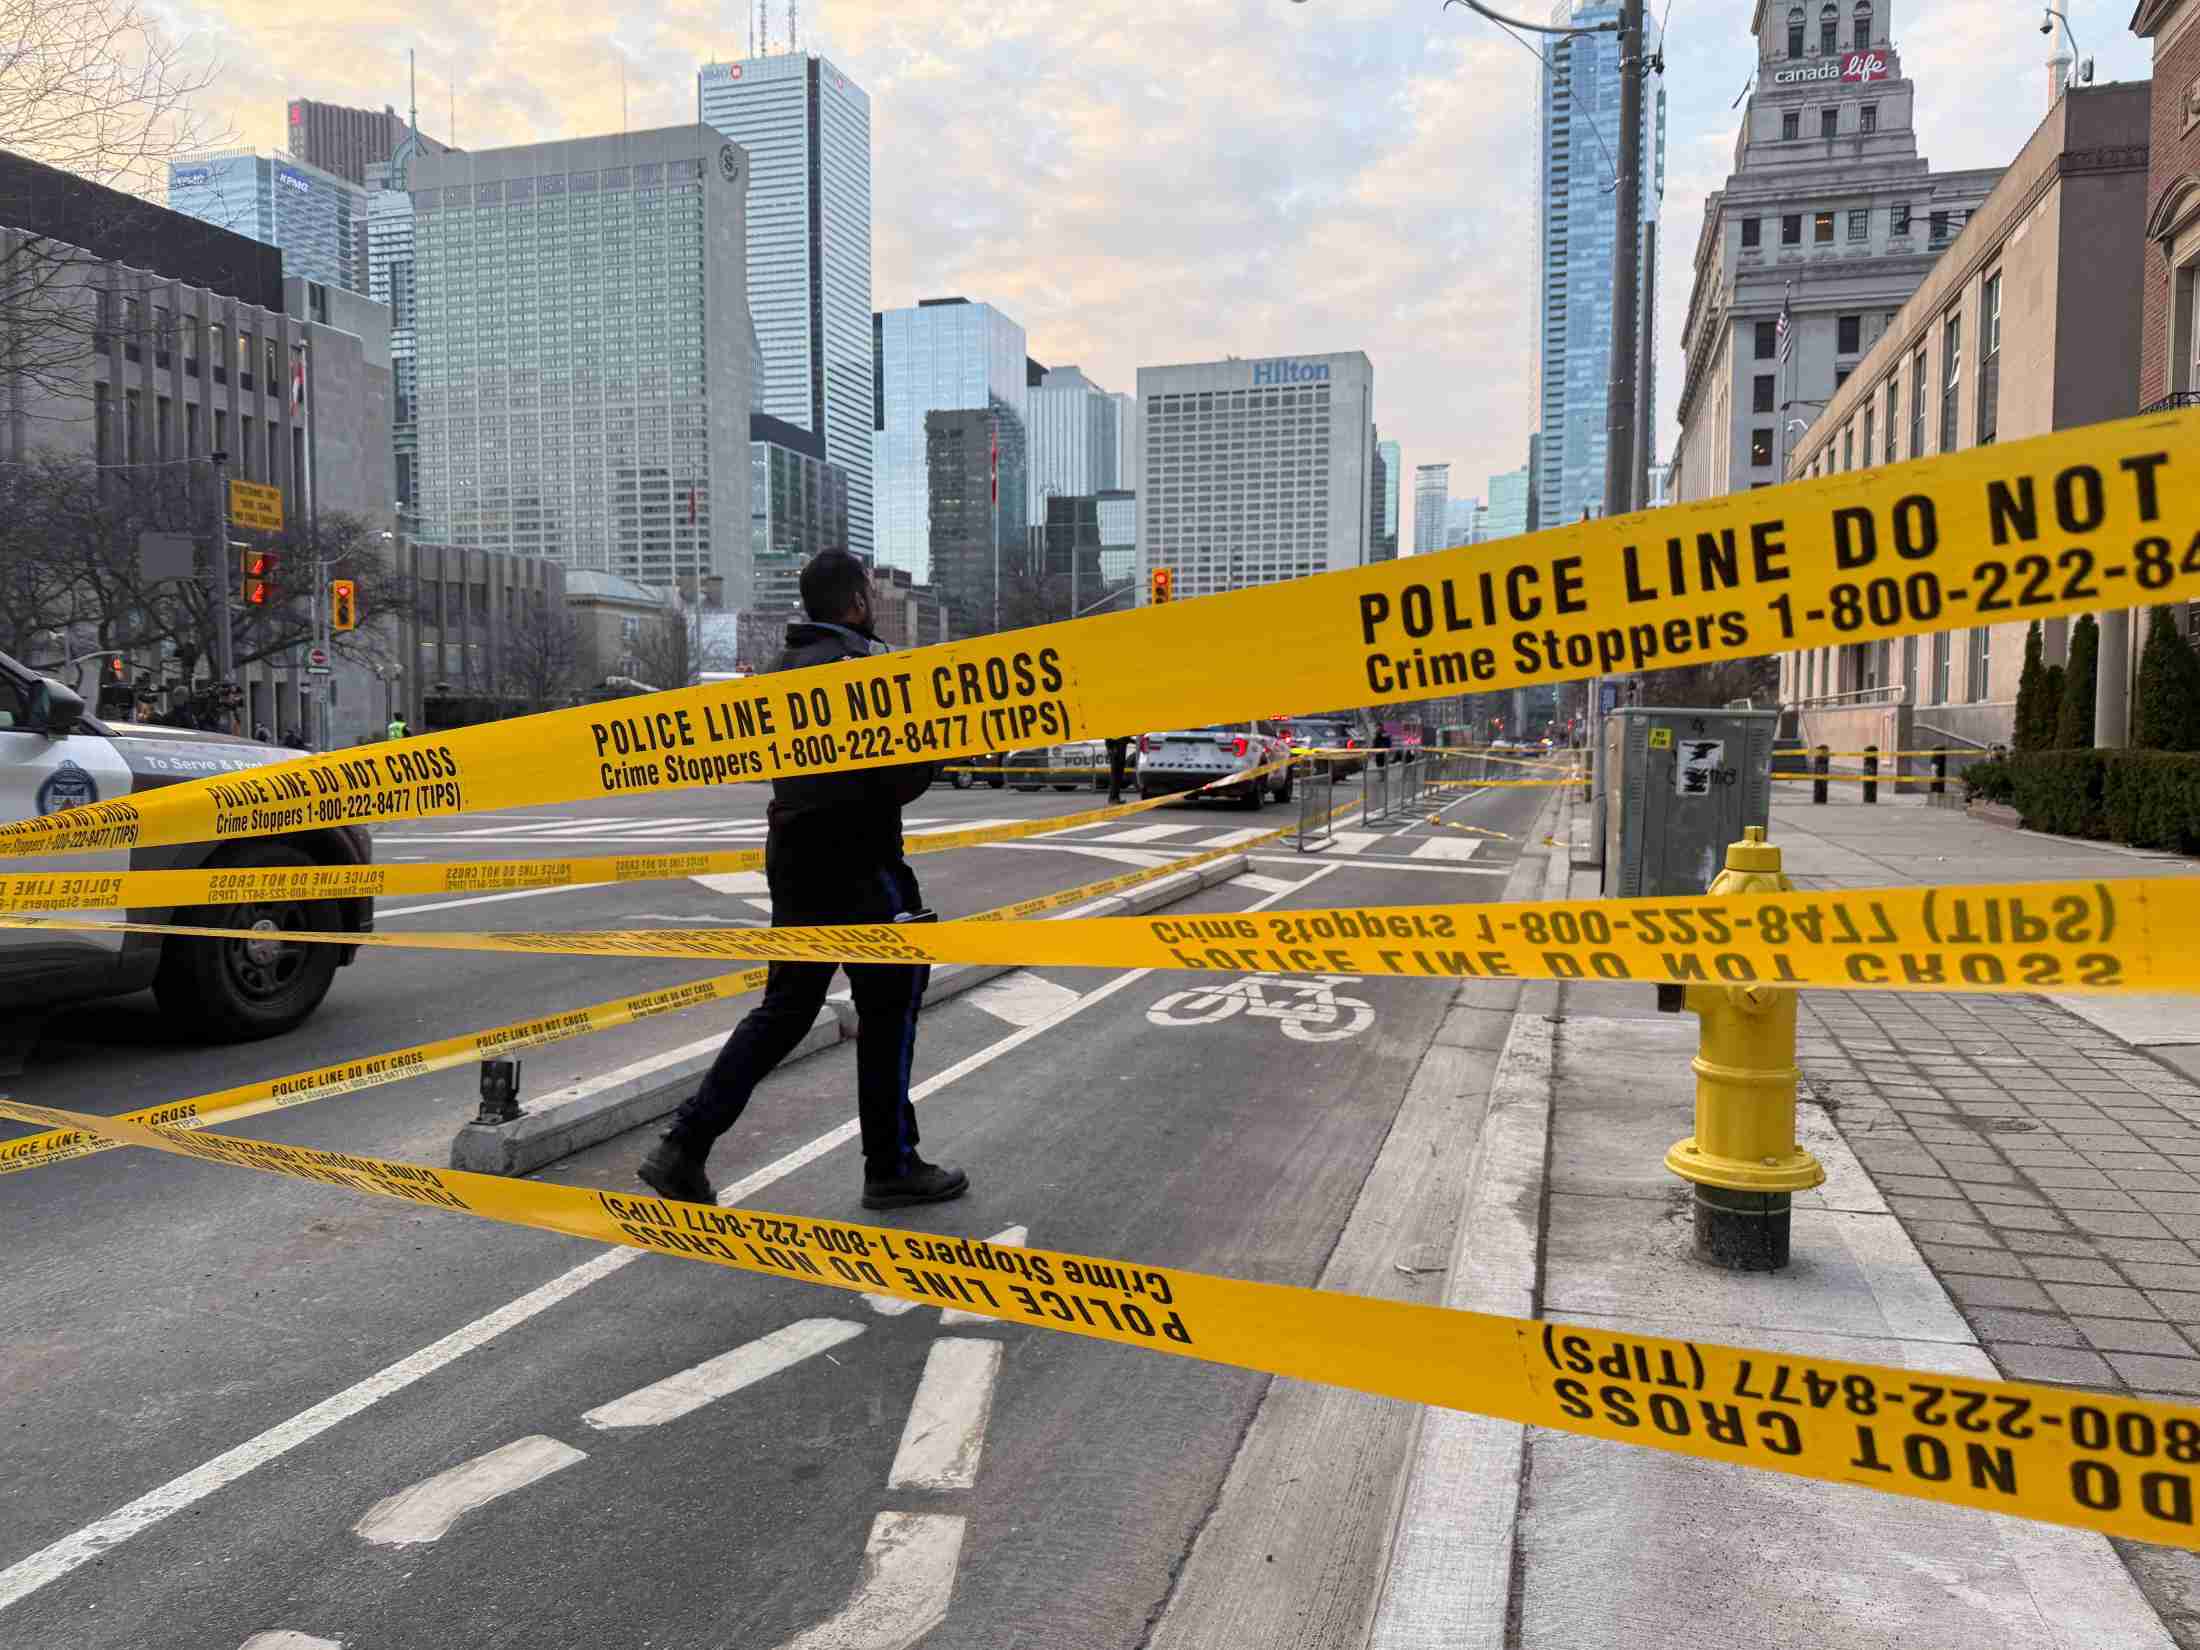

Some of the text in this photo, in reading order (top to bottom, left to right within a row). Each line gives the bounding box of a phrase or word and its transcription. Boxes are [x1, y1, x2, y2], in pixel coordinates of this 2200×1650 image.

[1774, 54, 1887, 83] canada life
[280, 173, 309, 192] KPMG
[1254, 360, 1328, 384] Hilton
[1359, 451, 2169, 645] POLICE LINE DO NOT
[1366, 646, 1496, 694] Crime
[1513, 609, 1748, 676] Stoppers
[590, 648, 1063, 757] POLICE LINE DO NOT CROSS
[145, 756, 169, 769] To
[170, 757, 217, 770] Serve
[600, 700, 1071, 790] Crime Stoppers 1-800-222-8477 (TIPS)
[206, 746, 457, 809] POLICE LINE DO NOT CROSS
[96, 803, 139, 824] CROSS
[110, 823, 139, 848] (TIPS)
[216, 782, 462, 834] Crime Stoppers 1-800-222-8477 (TIPS)
[476, 1032, 508, 1048] POLICE
[510, 1026, 530, 1041] LINE
[532, 1022, 543, 1036] DO
[545, 1017, 561, 1032] NOT
[563, 1012, 589, 1028] CROSS
[271, 1051, 425, 1097] POLICE LINE DO NOT CROSS
[0, 1140, 38, 1160] LICE
[46, 1131, 81, 1151] LINE
[150, 1103, 197, 1126] CROSS
[599, 1191, 1173, 1305] Crime Stoppers 1-800-222-8477 (TIPS)
[619, 1223, 1193, 1344] POLICE LINE DO NOT CROSS
[1541, 1324, 1705, 1392] (TIPS)
[1552, 1378, 2194, 1527] DO NOT CROSS
